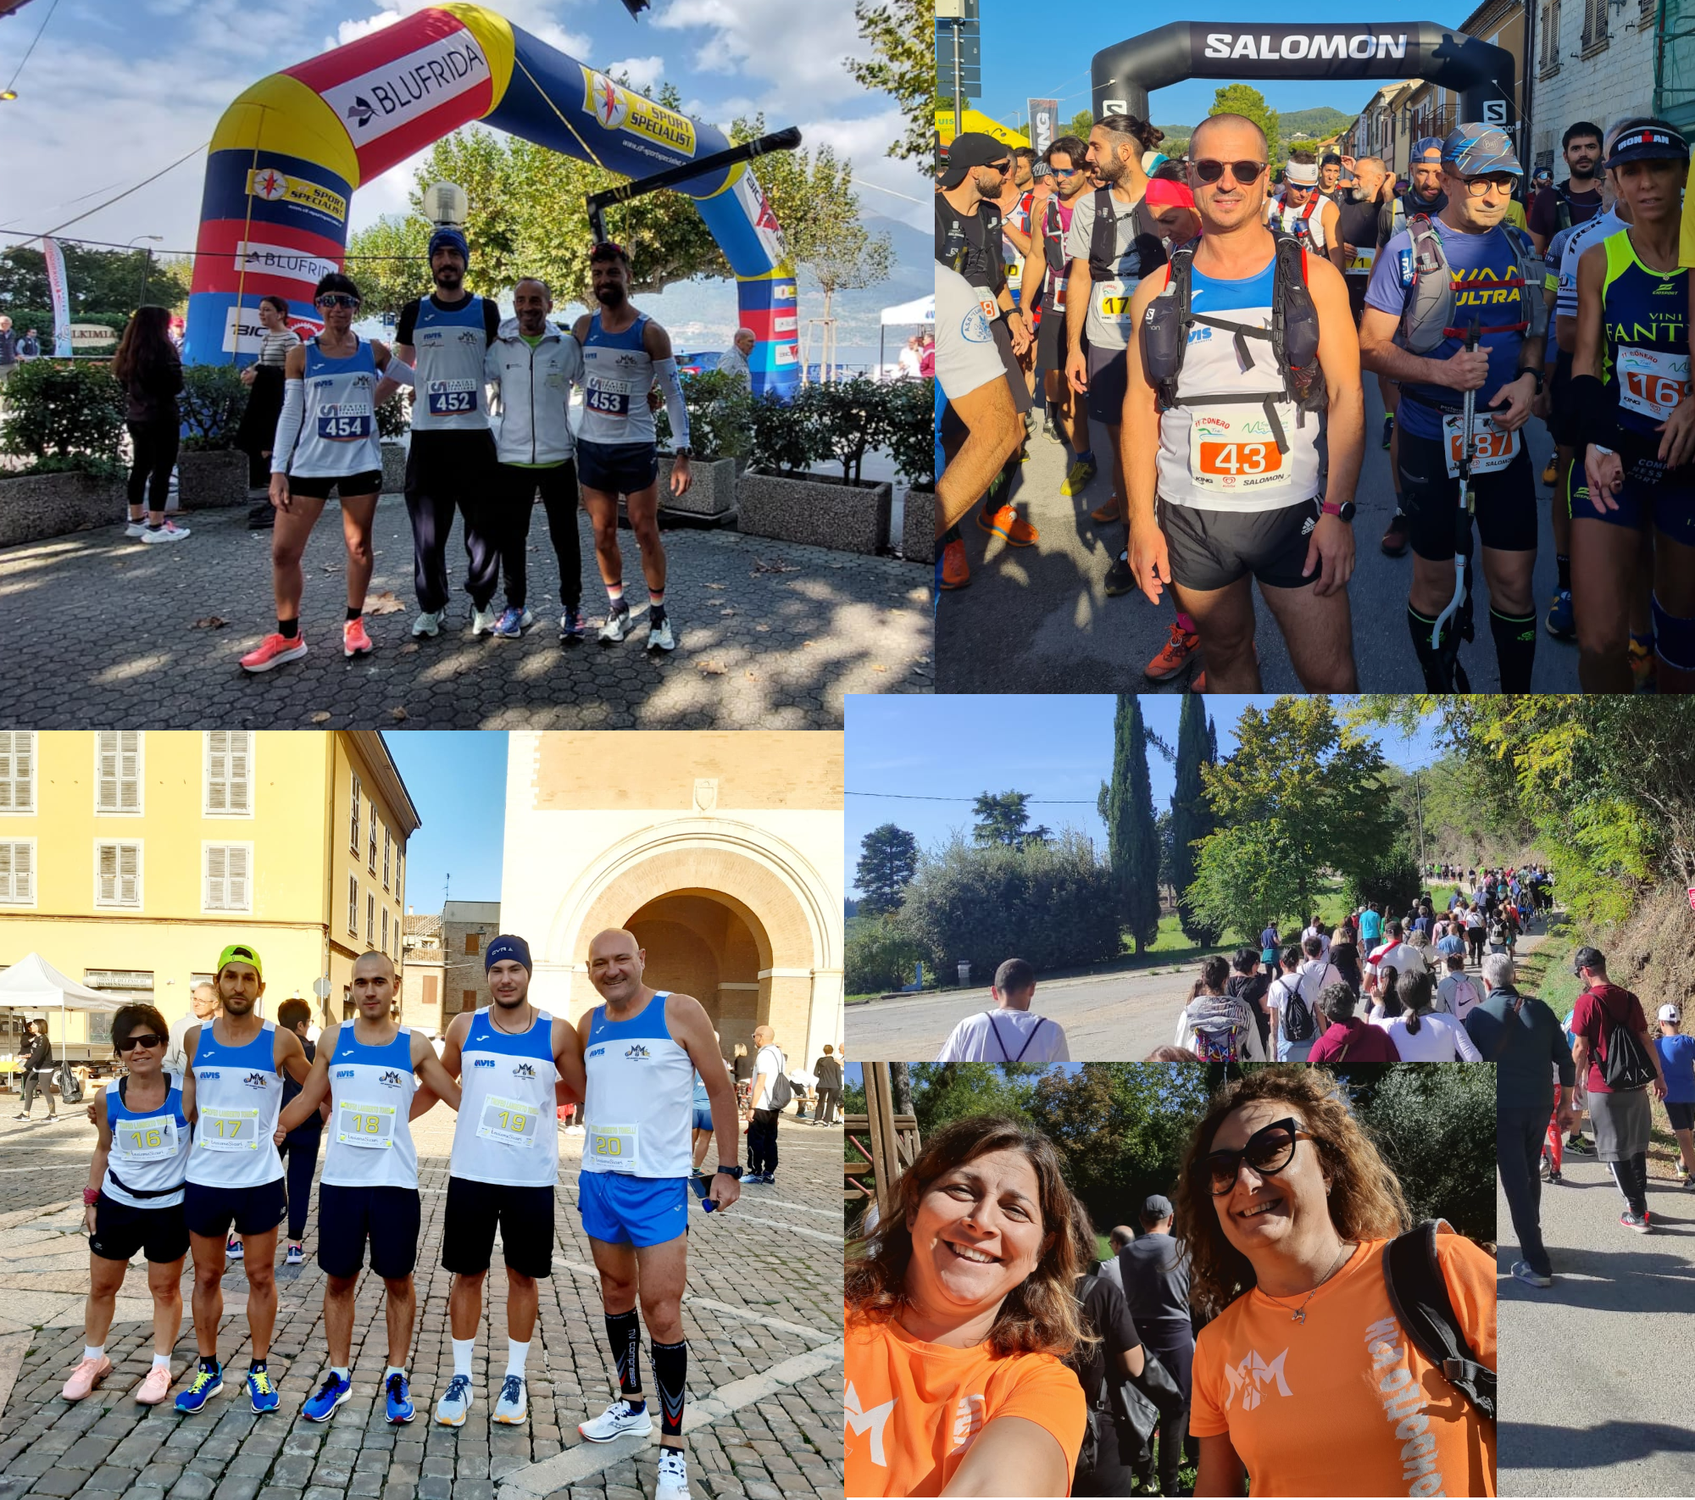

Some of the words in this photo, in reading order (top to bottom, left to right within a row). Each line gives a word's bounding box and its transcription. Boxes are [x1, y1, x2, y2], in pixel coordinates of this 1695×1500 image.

[1204, 33, 1407, 60] SALOMON
[371, 44, 484, 115] BLUFRIDA
[630, 111, 692, 148] SPECIALIST
[651, 107, 690, 133] SPORT
[1036, 112, 1050, 156] ING
[1618, 130, 1670, 151] IRONMAN
[290, 190, 343, 216] SPECIALIST
[314, 188, 344, 207] SPORT
[264, 252, 336, 279] BLUFRID
[1456, 289, 1521, 307] ULTRA
[1649, 312, 1682, 321] VINI
[1605, 322, 1691, 342] FANT
[436, 392, 471, 411] 452
[590, 392, 621, 412] 453
[325, 417, 362, 437] 454
[1202, 417, 1231, 430] CONERO
[1215, 443, 1267, 475] 43
[1243, 473, 1285, 487] SALOMON
[474, 1059, 496, 1068] AVIS
[200, 1071, 221, 1079] AVIS
[336, 1069, 354, 1079] AVIS
[214, 1119, 242, 1138] 17
[352, 1114, 380, 1133] 18
[499, 1111, 527, 1132] 19
[131, 1129, 162, 1149] 16
[596, 1136, 622, 1156] 20
